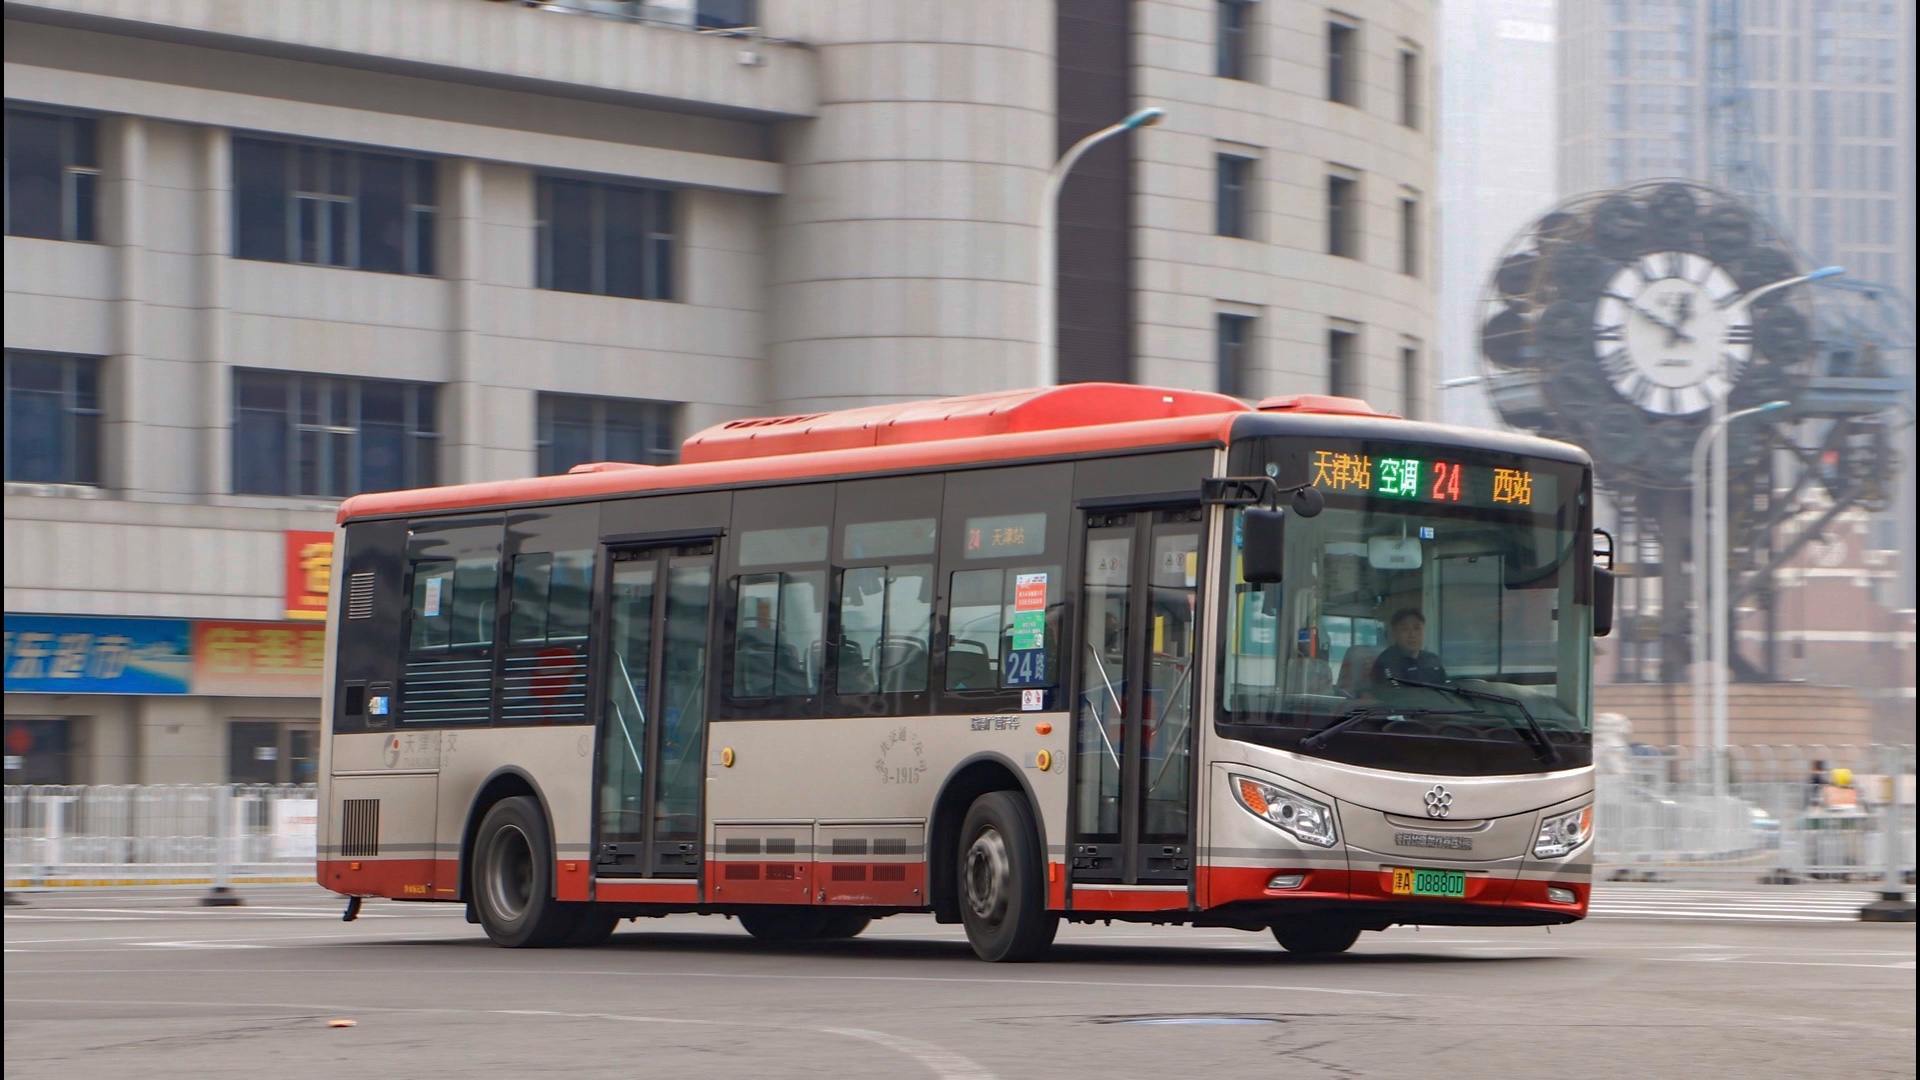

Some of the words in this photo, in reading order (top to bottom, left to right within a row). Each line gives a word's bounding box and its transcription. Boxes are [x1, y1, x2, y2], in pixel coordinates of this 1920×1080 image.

[1312, 450, 1372, 490] 天津站
[1379, 457, 1420, 497] 空调
[1432, 461, 1462, 501] 24
[1493, 468, 1533, 505] 西站
[968, 528, 981, 550] 24
[991, 526, 1025, 546] 天津站
[4, 632, 133, 679] 东超市
[882, 766, 921, 785] 3-1915
